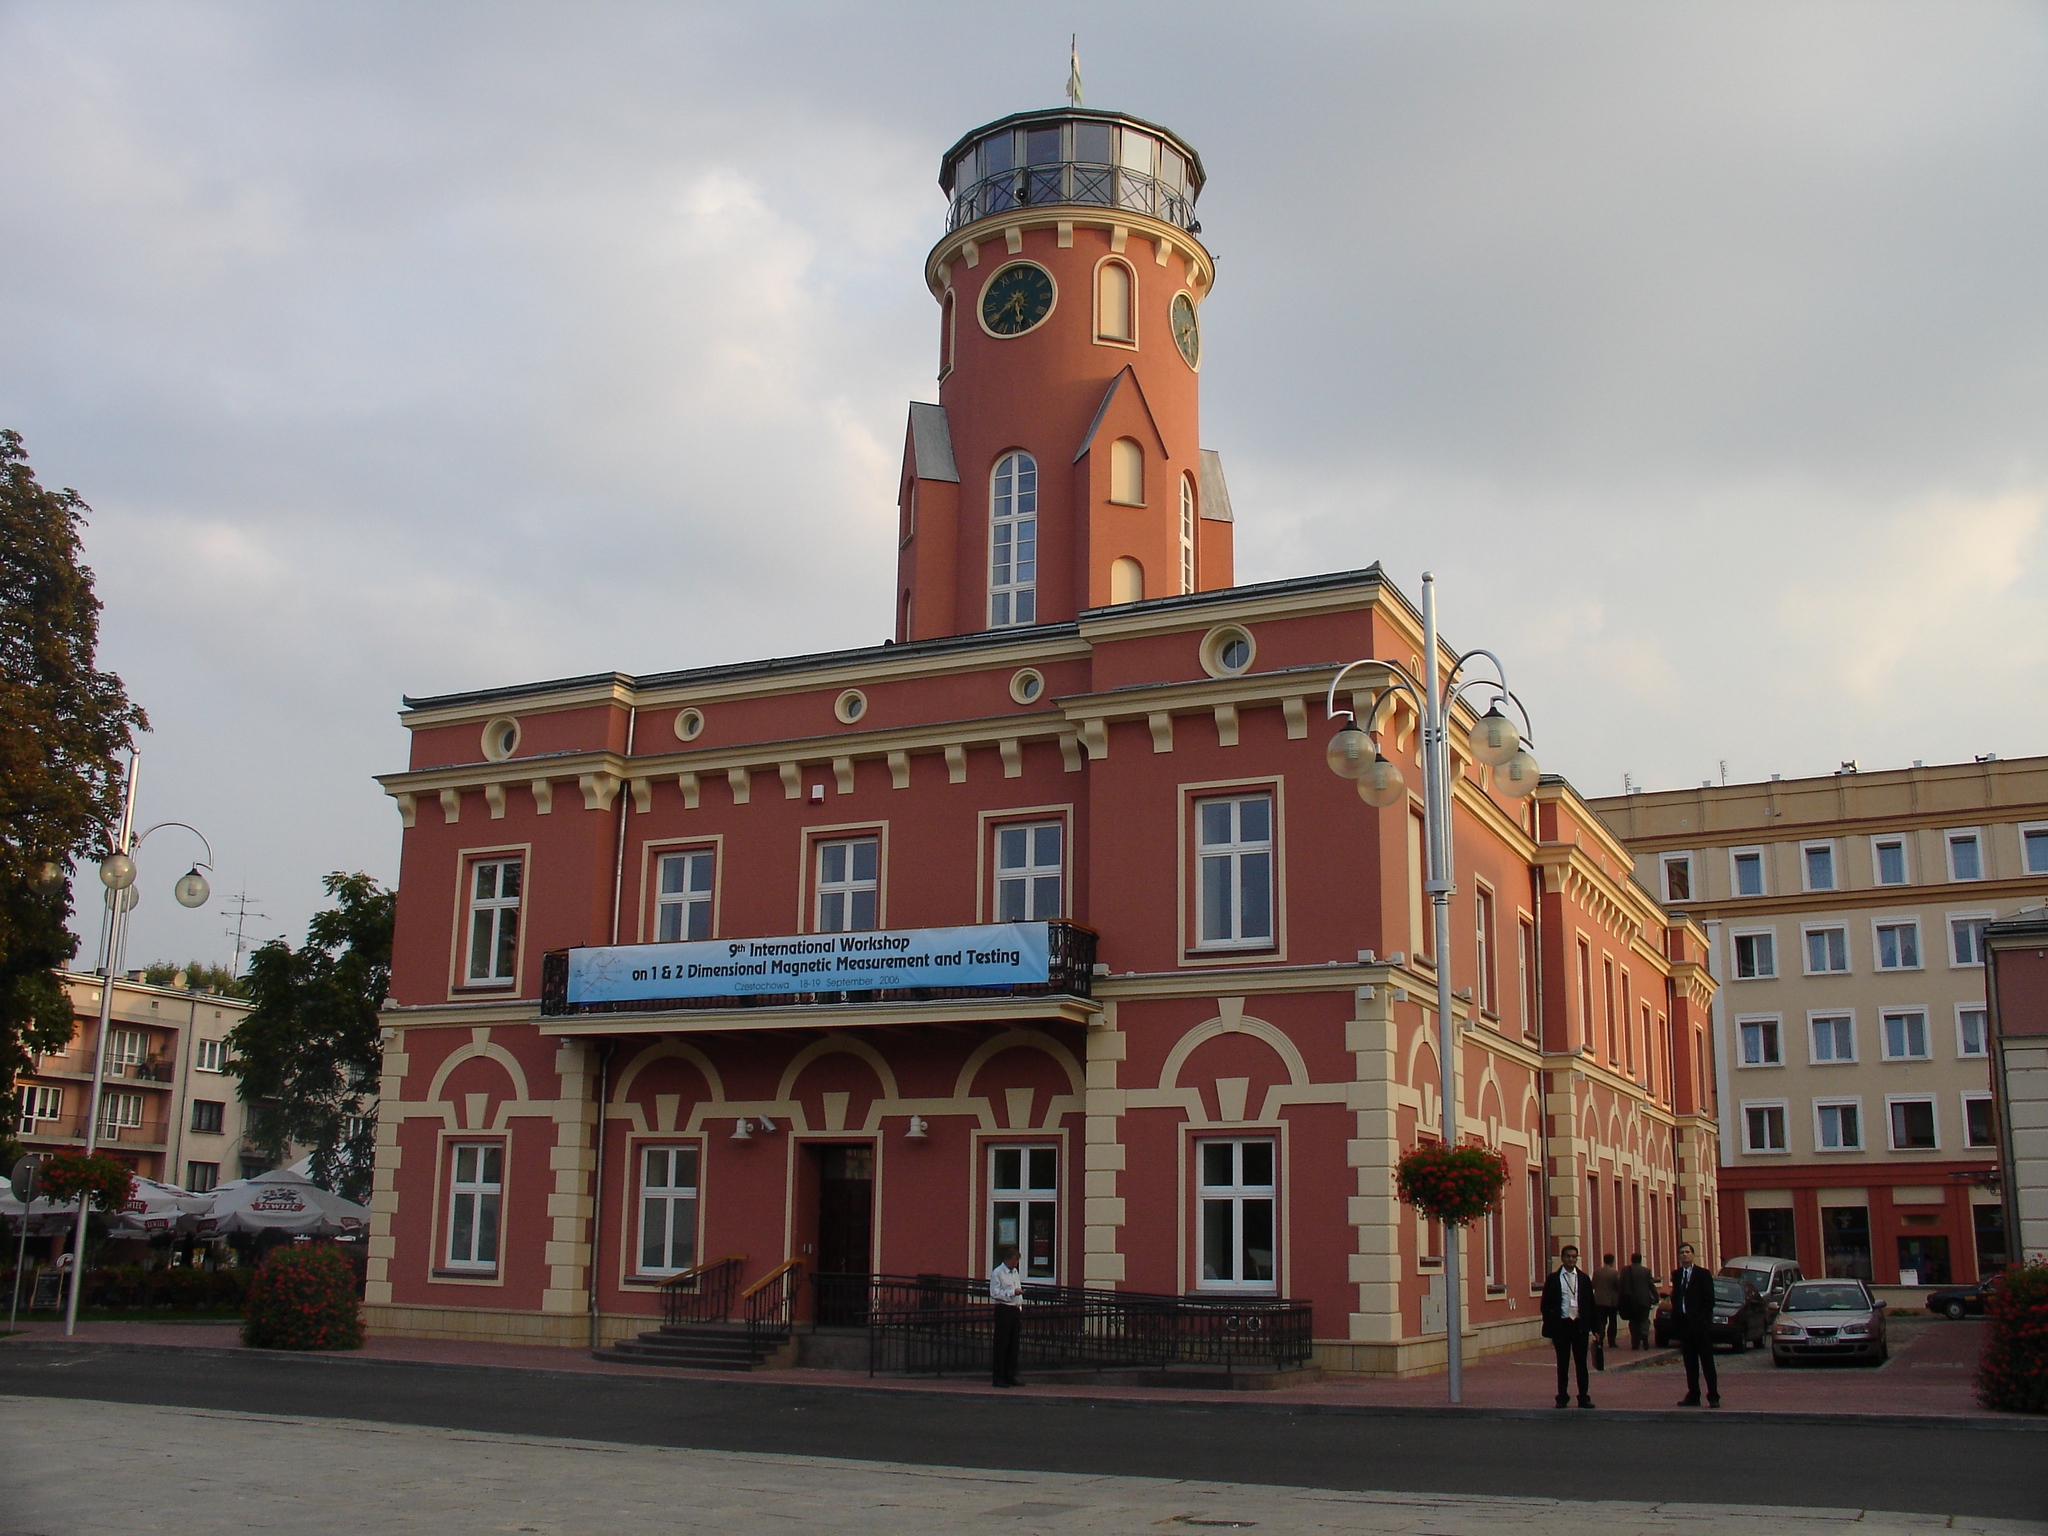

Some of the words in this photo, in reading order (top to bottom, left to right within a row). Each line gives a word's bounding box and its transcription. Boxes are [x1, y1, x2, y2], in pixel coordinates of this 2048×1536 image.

[729, 943, 746, 958] 9th
[750, 939, 835, 957] International
[840, 935, 910, 953] Workshop
[632, 969, 648, 981] on
[652, 966, 657, 980] 1
[661, 966, 671, 980] &
[675, 965, 684, 979] 2
[688, 961, 766, 978] Dimensional
[771, 957, 832, 977] Magnetic
[836, 953, 930, 971] Measurement
[934, 950, 962, 967] and
[966, 948, 1020, 967] Testing
[800, 978, 821, 988] 18-19
[826, 977, 874, 989] September
[879, 975, 900, 985] 2006
